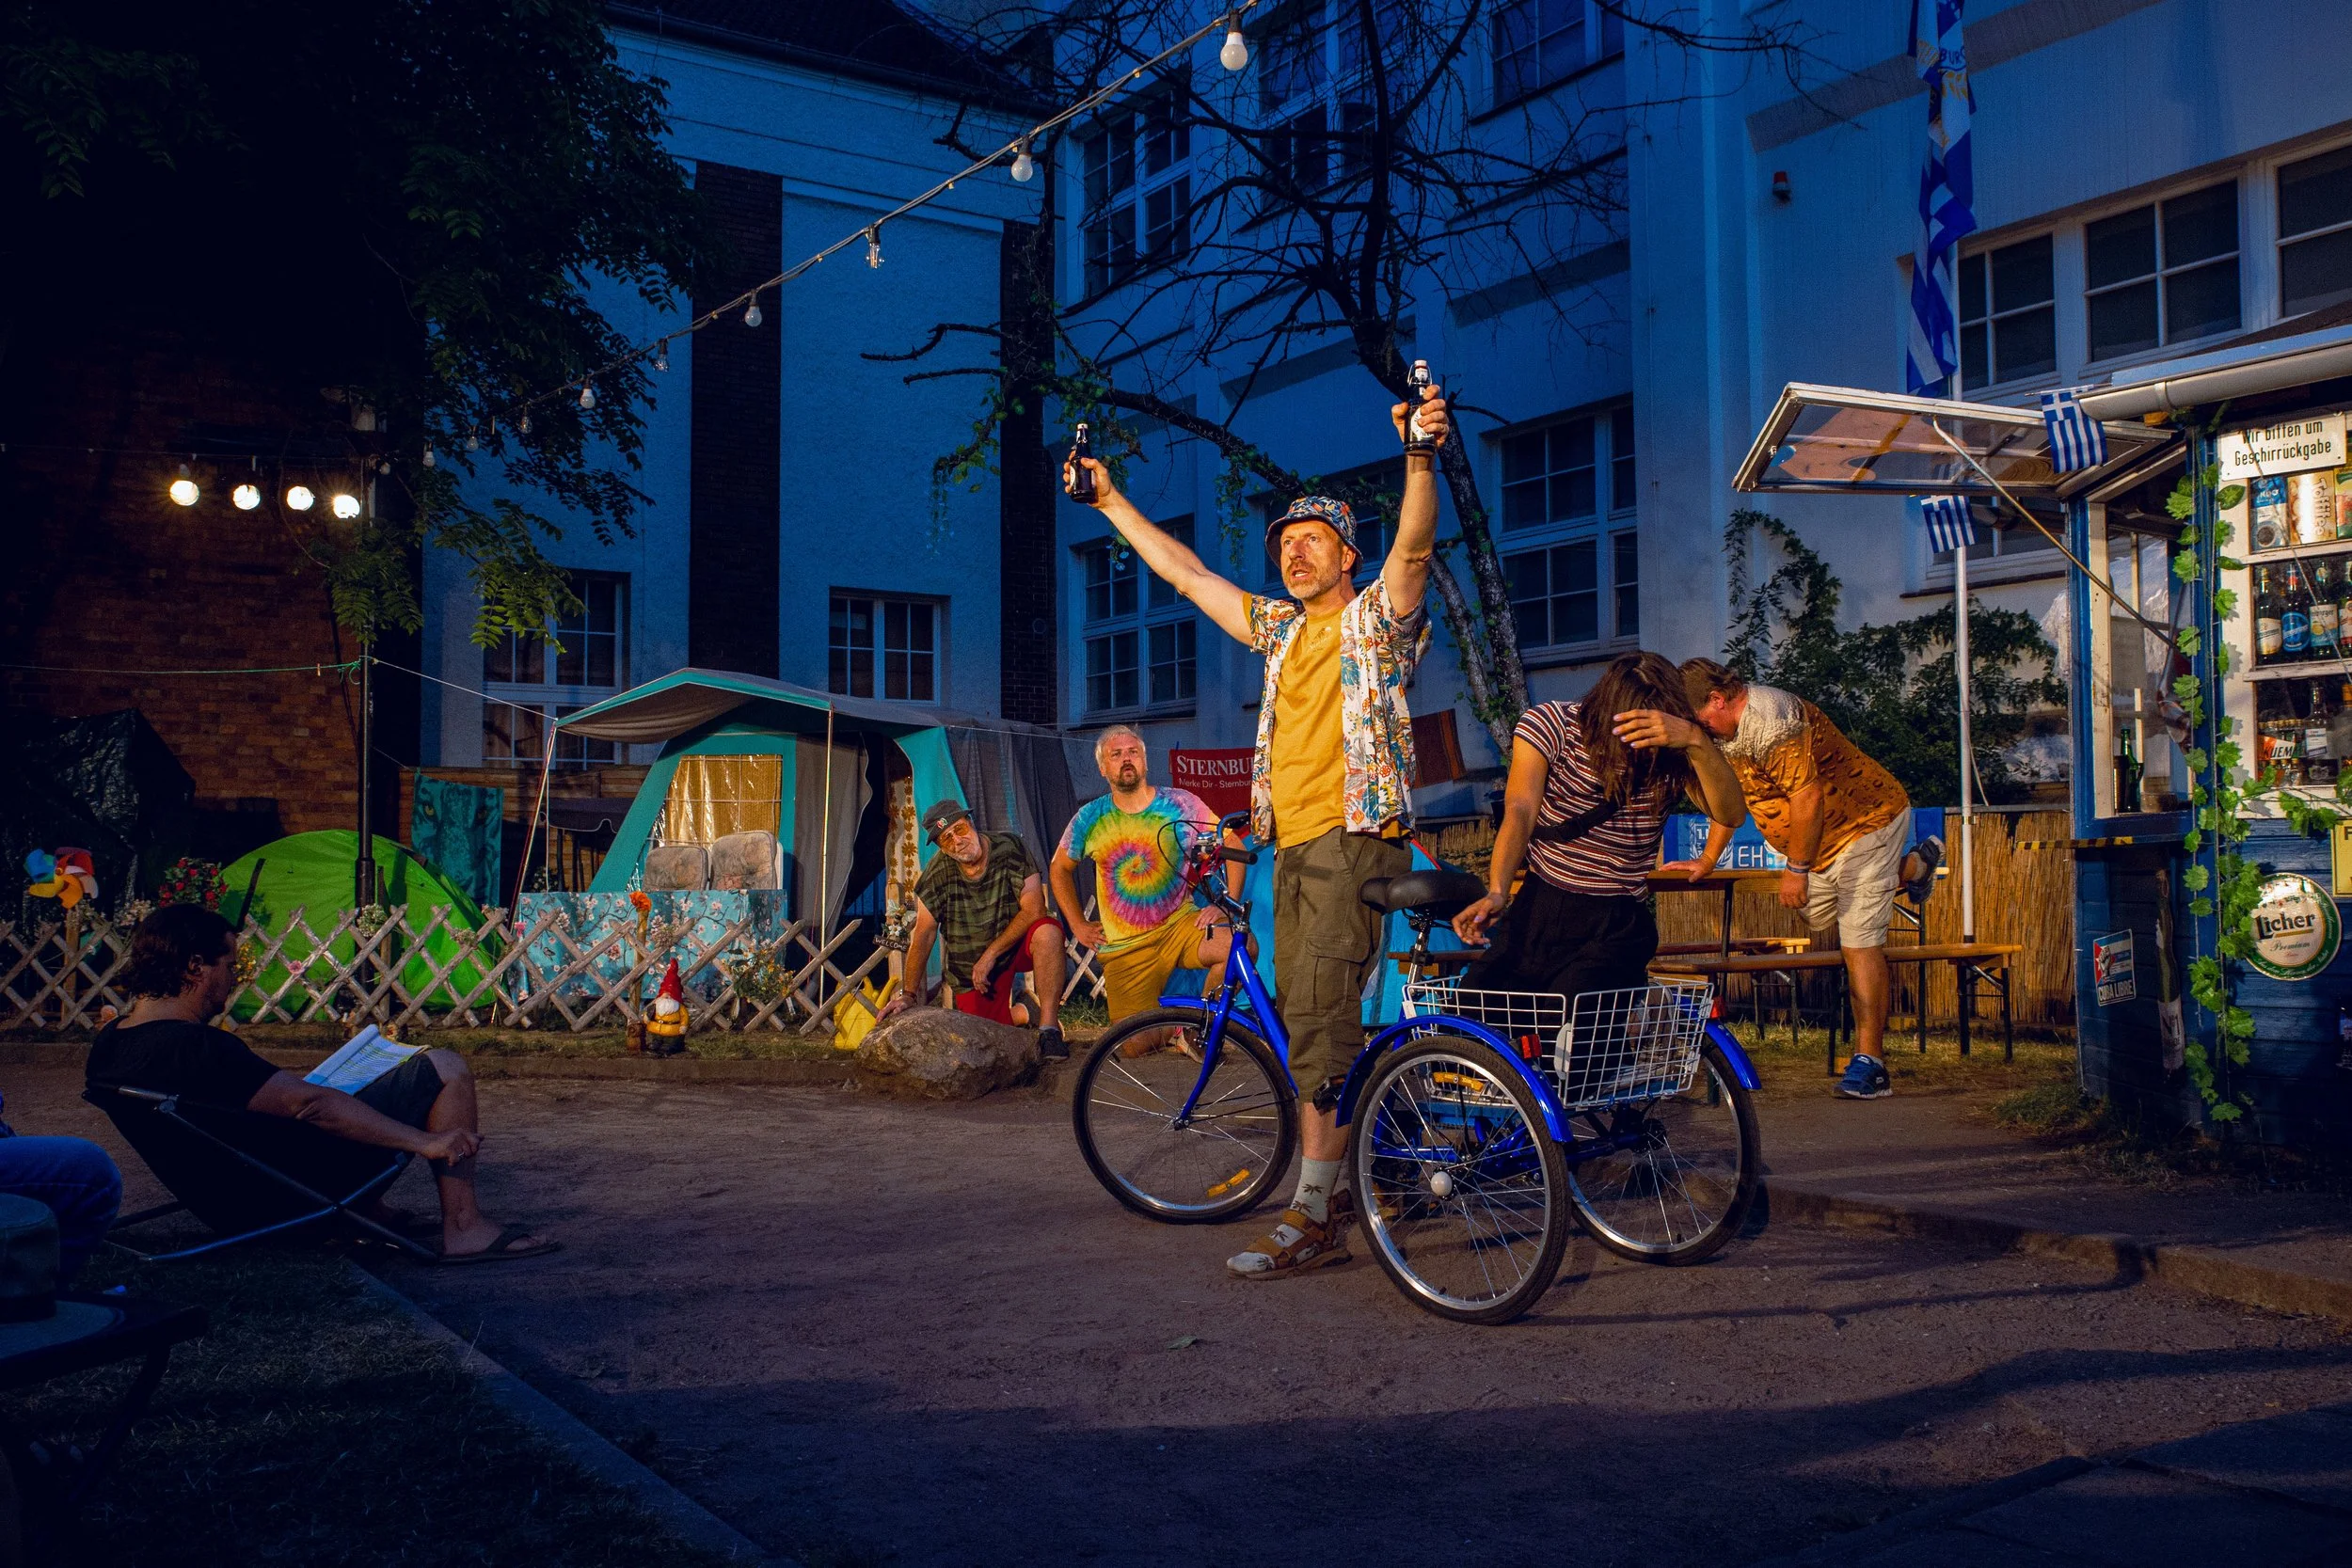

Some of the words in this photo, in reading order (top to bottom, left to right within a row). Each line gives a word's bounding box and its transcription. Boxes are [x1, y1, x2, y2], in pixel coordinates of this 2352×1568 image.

[2265, 423, 2300, 441] bitten
[2306, 420, 2323, 435] um
[2234, 438, 2331, 467] Geschirrückgabe
[1179, 777, 1200, 788] Merke
[1202, 780, 1214, 788] Dir
[2256, 911, 2315, 940] Licher
[875, 937, 907, 951] WELCOME
[2269, 941, 2311, 952] Premium
[2098, 983, 2115, 1002] CUBA
[2114, 979, 2133, 998] LIBRE
